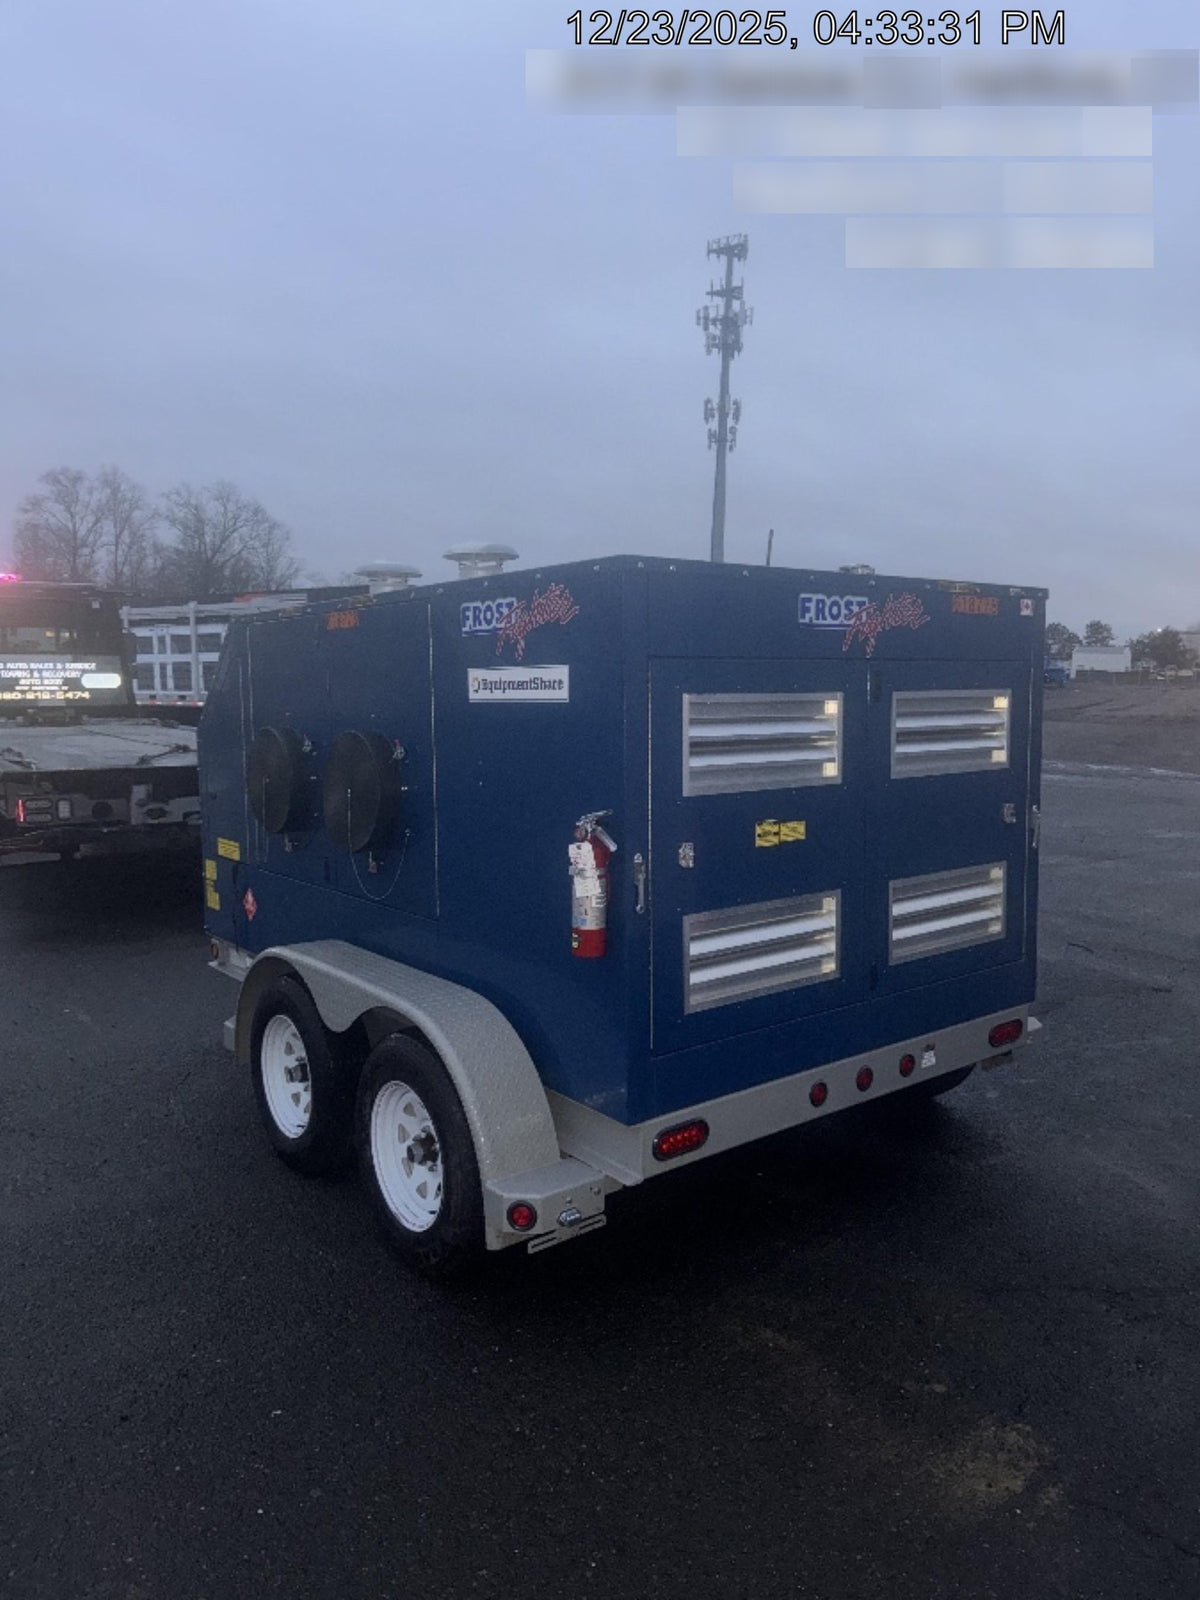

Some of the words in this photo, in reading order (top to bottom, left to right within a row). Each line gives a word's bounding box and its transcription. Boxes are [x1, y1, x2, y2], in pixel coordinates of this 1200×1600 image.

[461, 598, 517, 632] FROST
[798, 594, 869, 625] FROST
[481, 677, 564, 694] EquipmentShare
